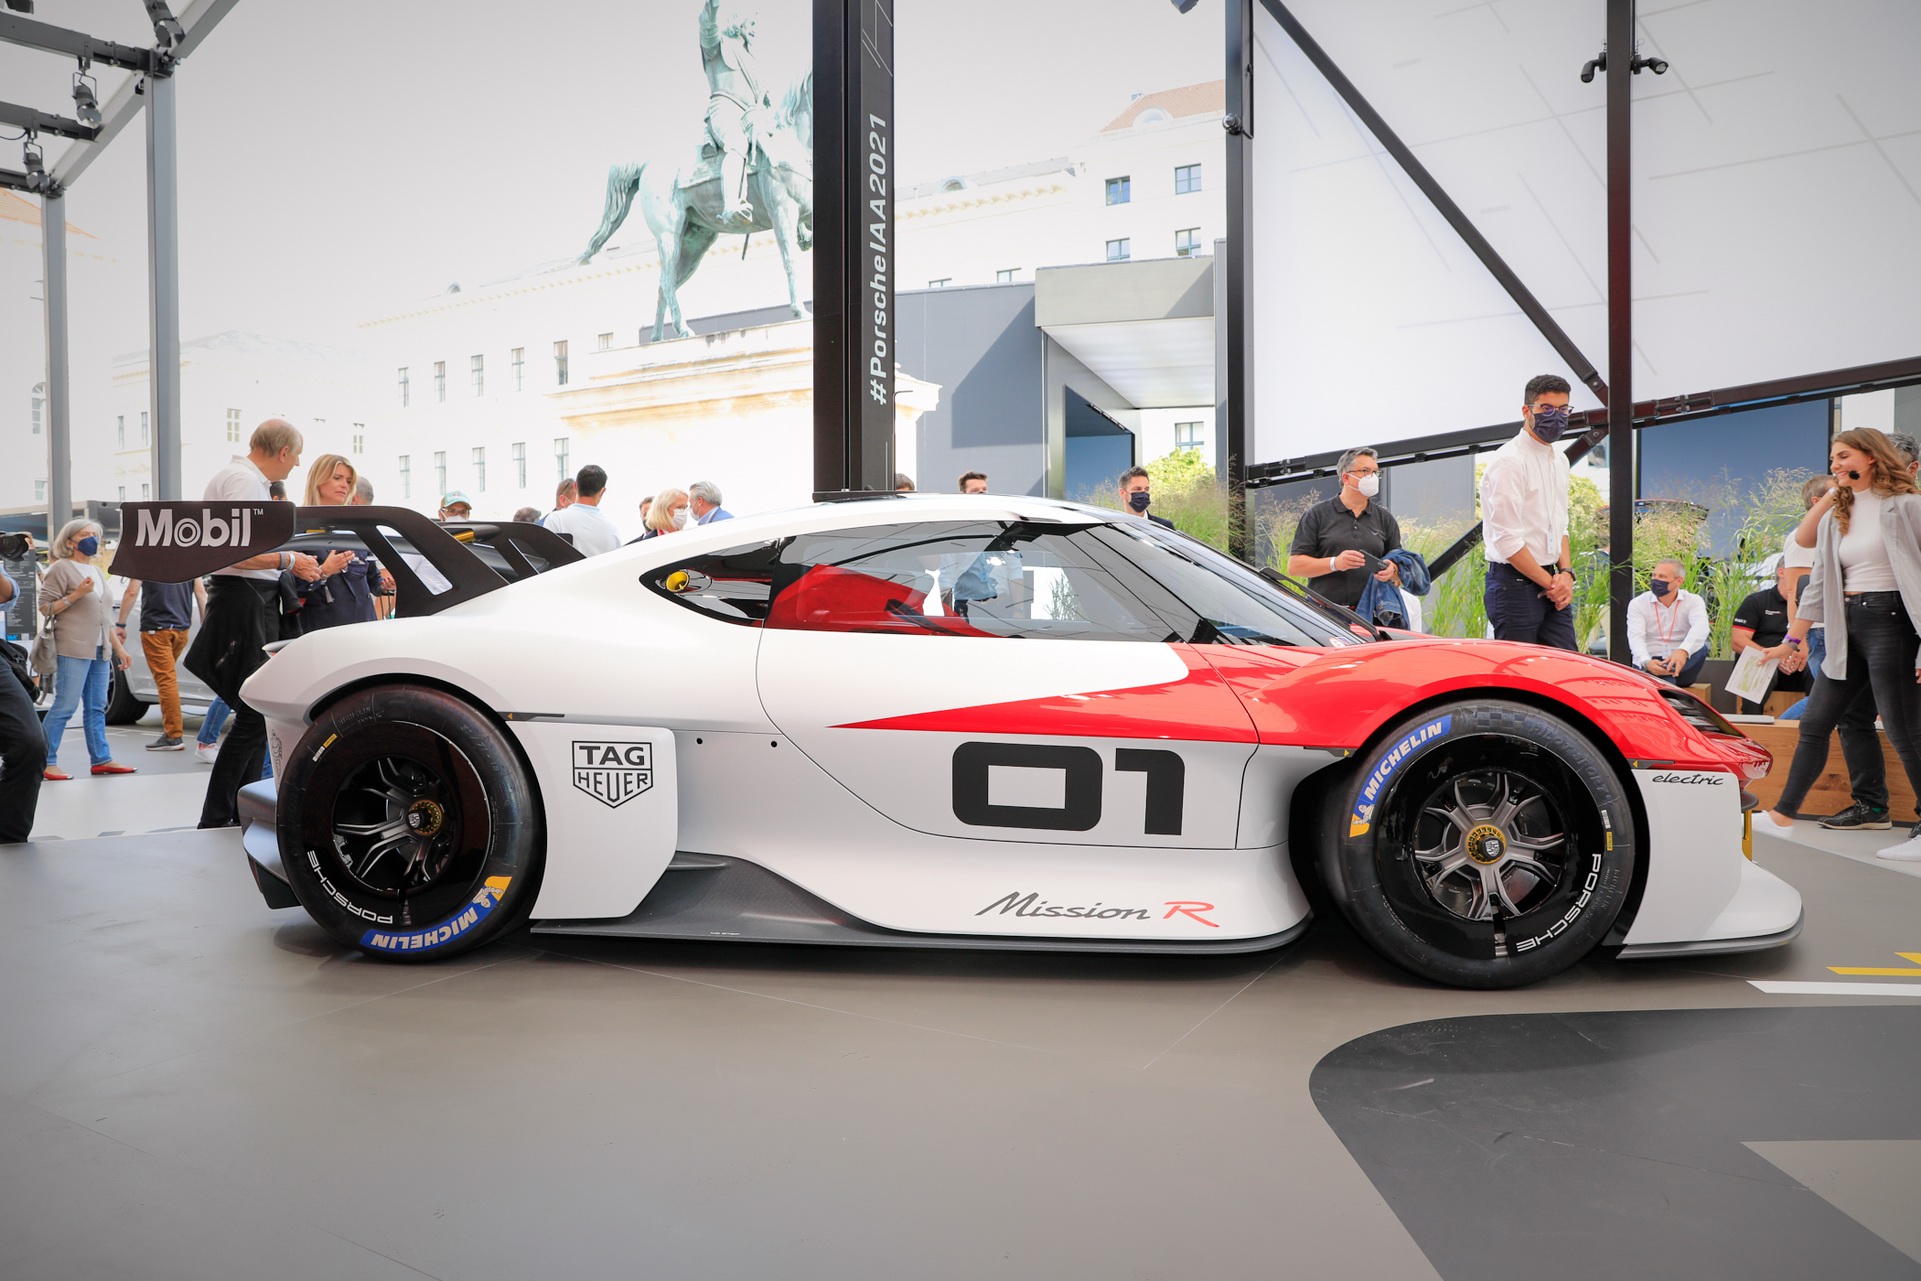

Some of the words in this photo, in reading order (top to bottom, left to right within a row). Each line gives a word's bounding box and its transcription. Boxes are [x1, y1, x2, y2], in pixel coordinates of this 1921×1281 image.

[869, 114, 887, 406] #PorscheIAA2021
[135, 508, 251, 548] Mobil
[578, 745, 645, 767] TAG
[1363, 721, 1442, 801] MICHELIN
[577, 771, 648, 803] HEUER
[952, 741, 1186, 836] 01
[1652, 772, 1724, 786] electric
[307, 850, 393, 925] PORSCHE
[1516, 853, 1602, 952] PORSCHE
[371, 907, 478, 949] MICHELIN
[975, 891, 1151, 920] Mission
[1162, 901, 1220, 928] R
